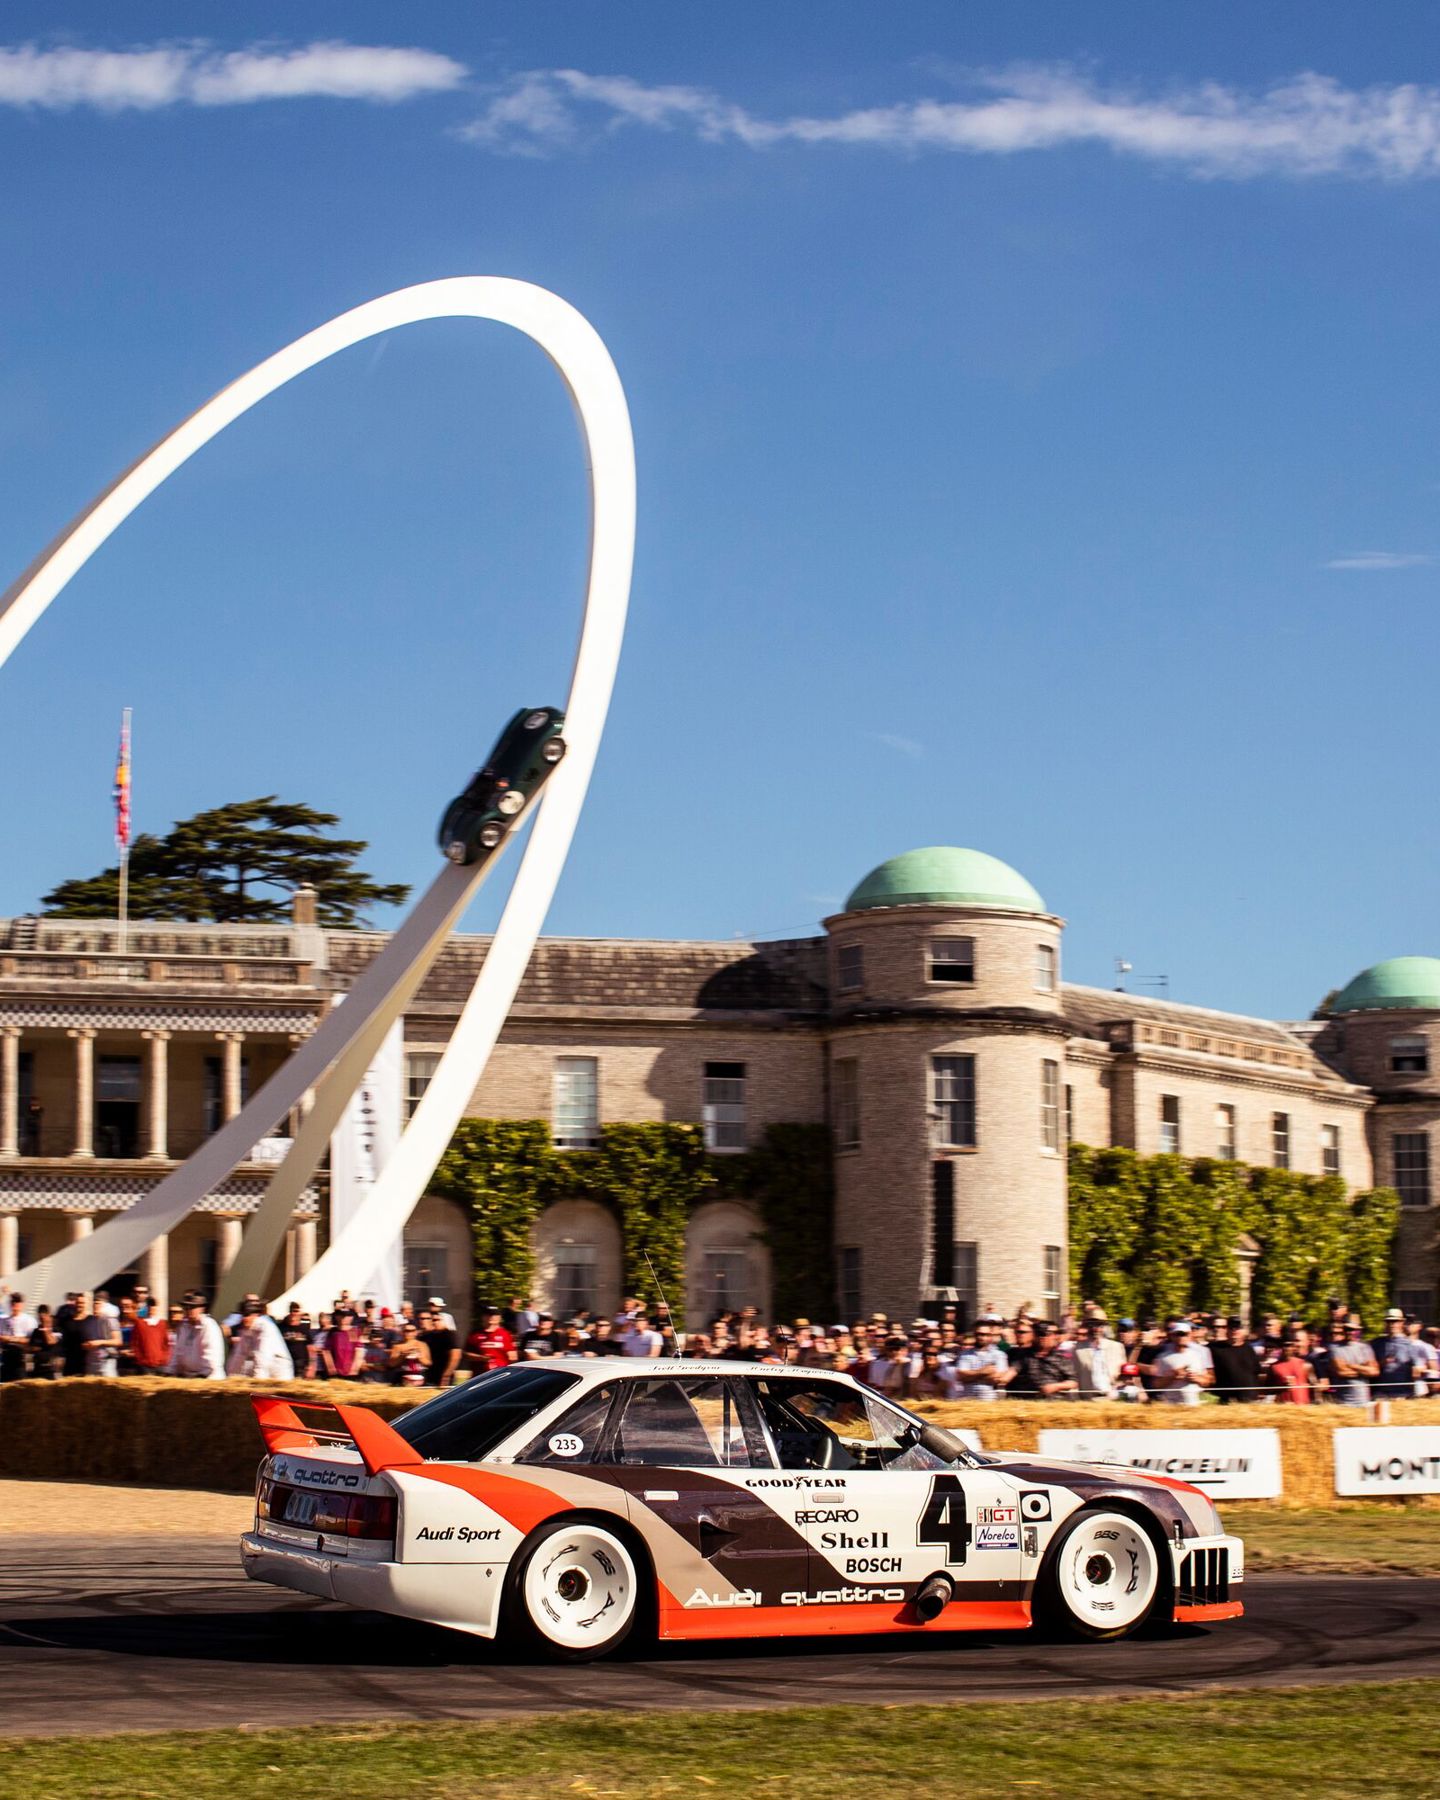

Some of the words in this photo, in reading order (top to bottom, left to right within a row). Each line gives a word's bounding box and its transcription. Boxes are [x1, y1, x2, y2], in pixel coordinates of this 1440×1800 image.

[555, 1439, 577, 1450] 235
[1131, 1458, 1252, 1473] MICHELIN
[1359, 1457, 1440, 1481] MONT
[294, 1469, 359, 1487] quattro
[795, 1509, 859, 1524] RECARO
[916, 1474, 972, 1567] 4
[994, 1509, 1015, 1521] GT
[416, 1527, 455, 1540] Audi
[457, 1527, 501, 1543] Sport
[821, 1532, 888, 1549] Shell
[978, 1527, 1015, 1542] Norelco
[1094, 1530, 1120, 1540] BBS
[592, 1549, 616, 1576] BBS
[846, 1557, 902, 1573] BOSCH
[684, 1587, 762, 1607] Audi
[781, 1586, 905, 1606] quattro
